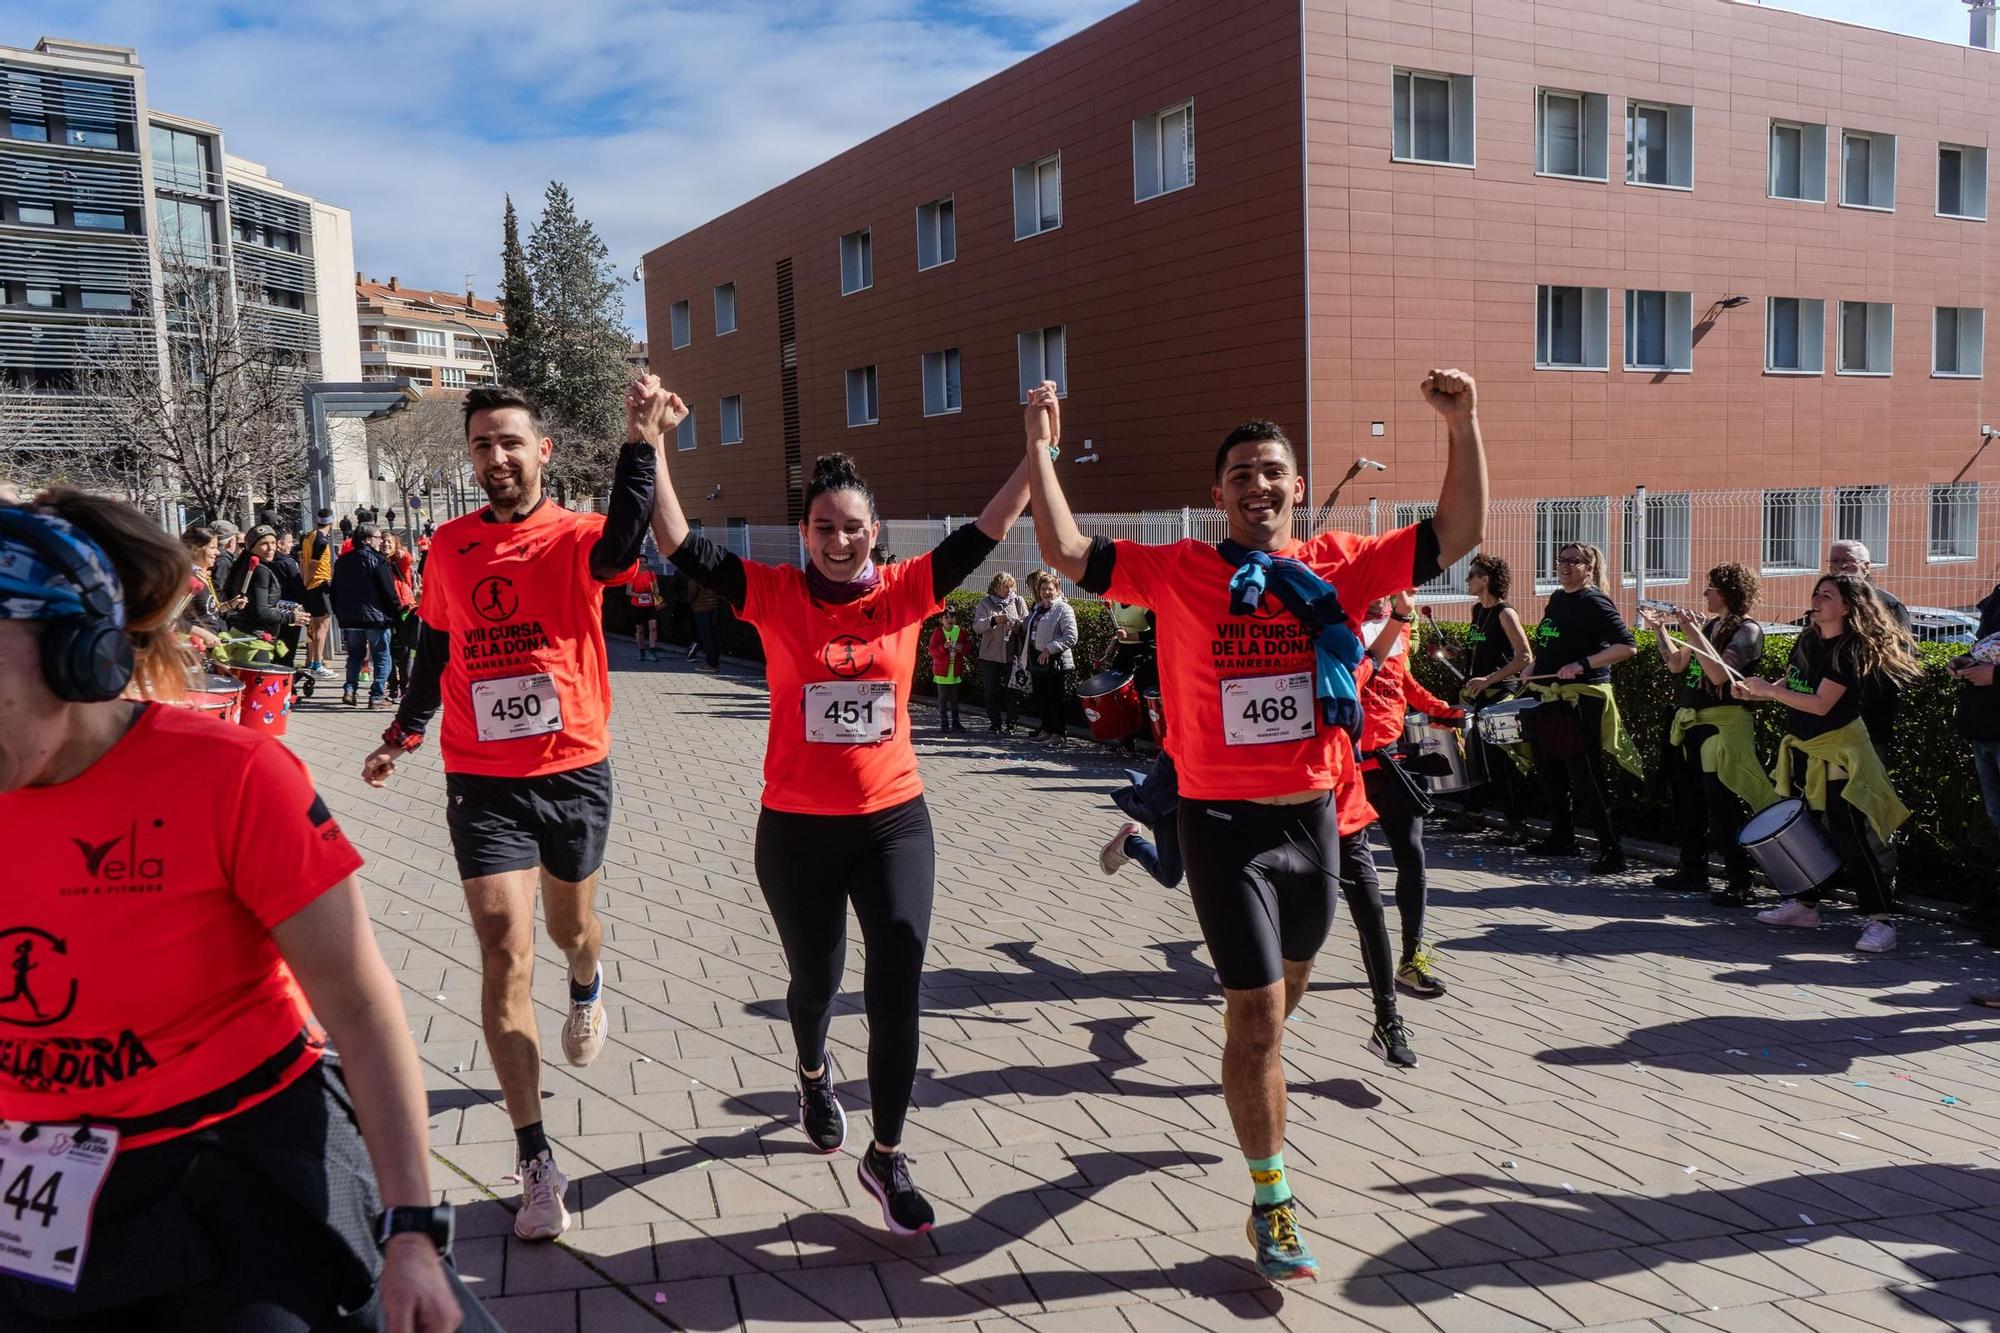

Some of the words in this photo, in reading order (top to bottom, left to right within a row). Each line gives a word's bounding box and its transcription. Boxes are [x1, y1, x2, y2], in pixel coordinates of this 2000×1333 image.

[464, 627, 486, 643] VIII
[489, 621, 544, 641] CURSA
[1216, 623, 1246, 639] VIII
[1249, 623, 1312, 639] CURSA
[463, 644, 478, 660] DE
[481, 642, 501, 656] LA
[504, 635, 551, 654] DONA
[1212, 640, 1234, 655] DE
[1238, 640, 1260, 655] LA
[1264, 639, 1315, 655] DONA
[492, 694, 541, 721] 450
[825, 700, 873, 724] 451
[1243, 696, 1297, 724] 468
[69, 819, 164, 881] Vela
[0, 1157, 64, 1229] 44
